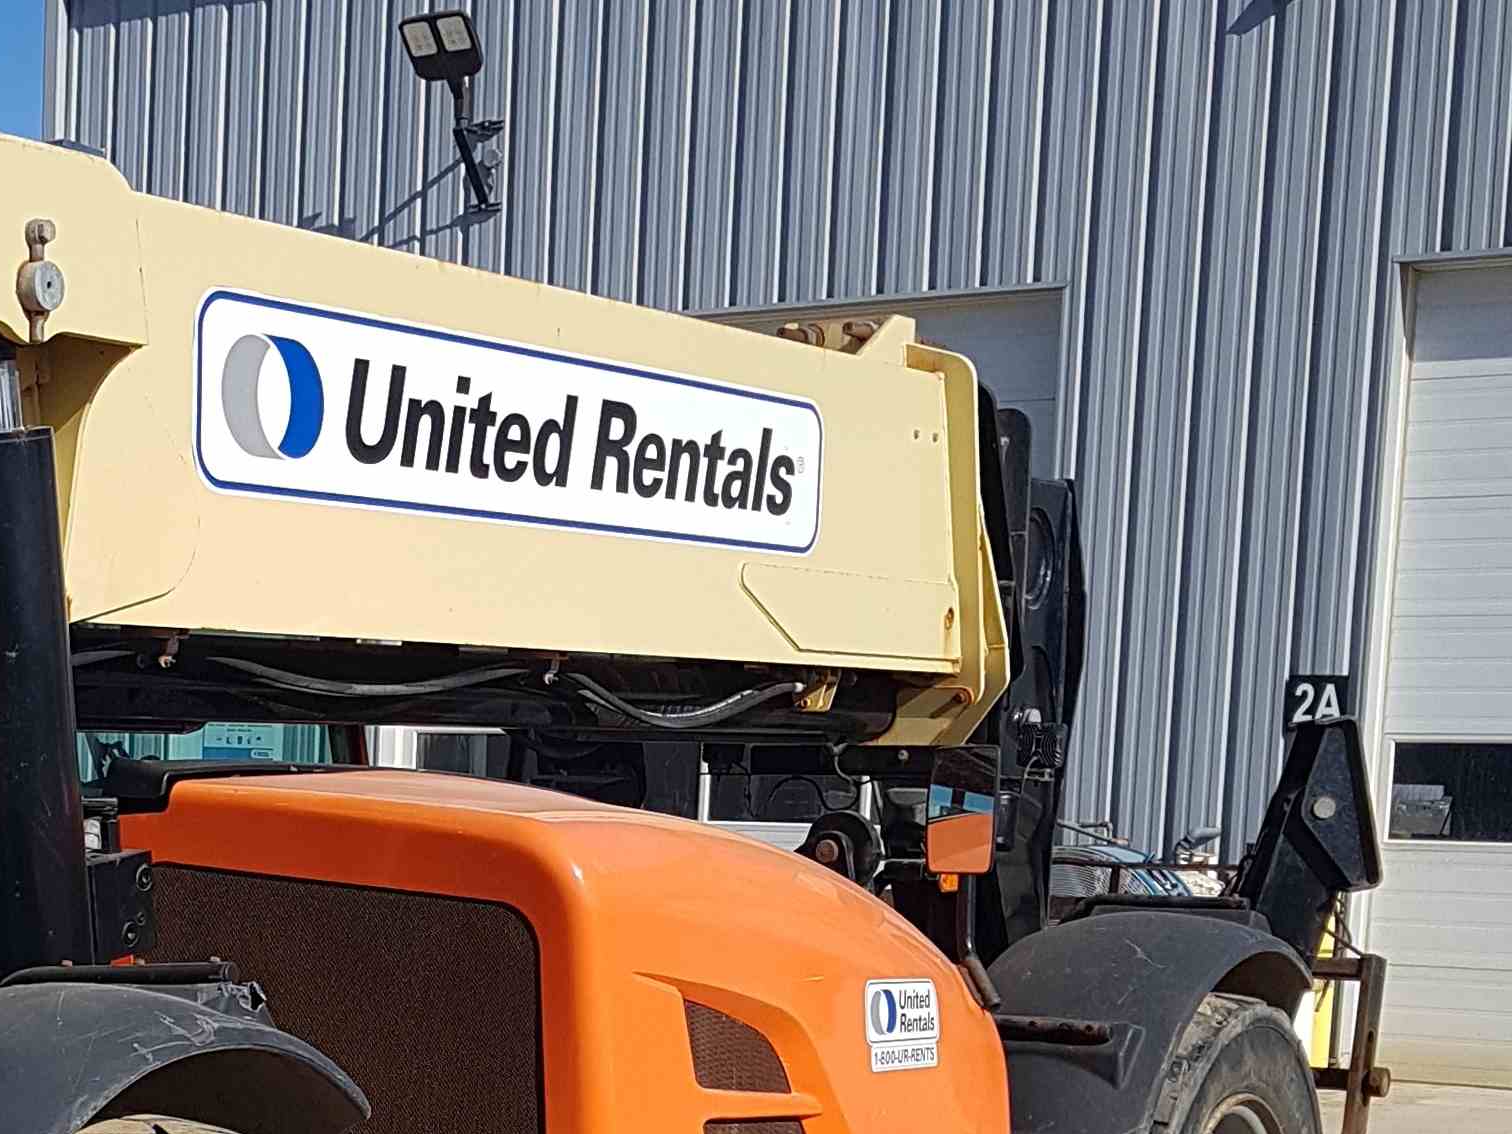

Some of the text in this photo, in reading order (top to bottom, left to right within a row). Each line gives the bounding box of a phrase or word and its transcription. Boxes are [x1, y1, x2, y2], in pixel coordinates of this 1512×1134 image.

[345, 357, 796, 516] United Rentals
[1293, 682, 1341, 722] 2A
[899, 989, 930, 1009] United
[900, 1012, 935, 1032] Rentals
[874, 1047, 935, 1065] 1-800-UR-RENTS
